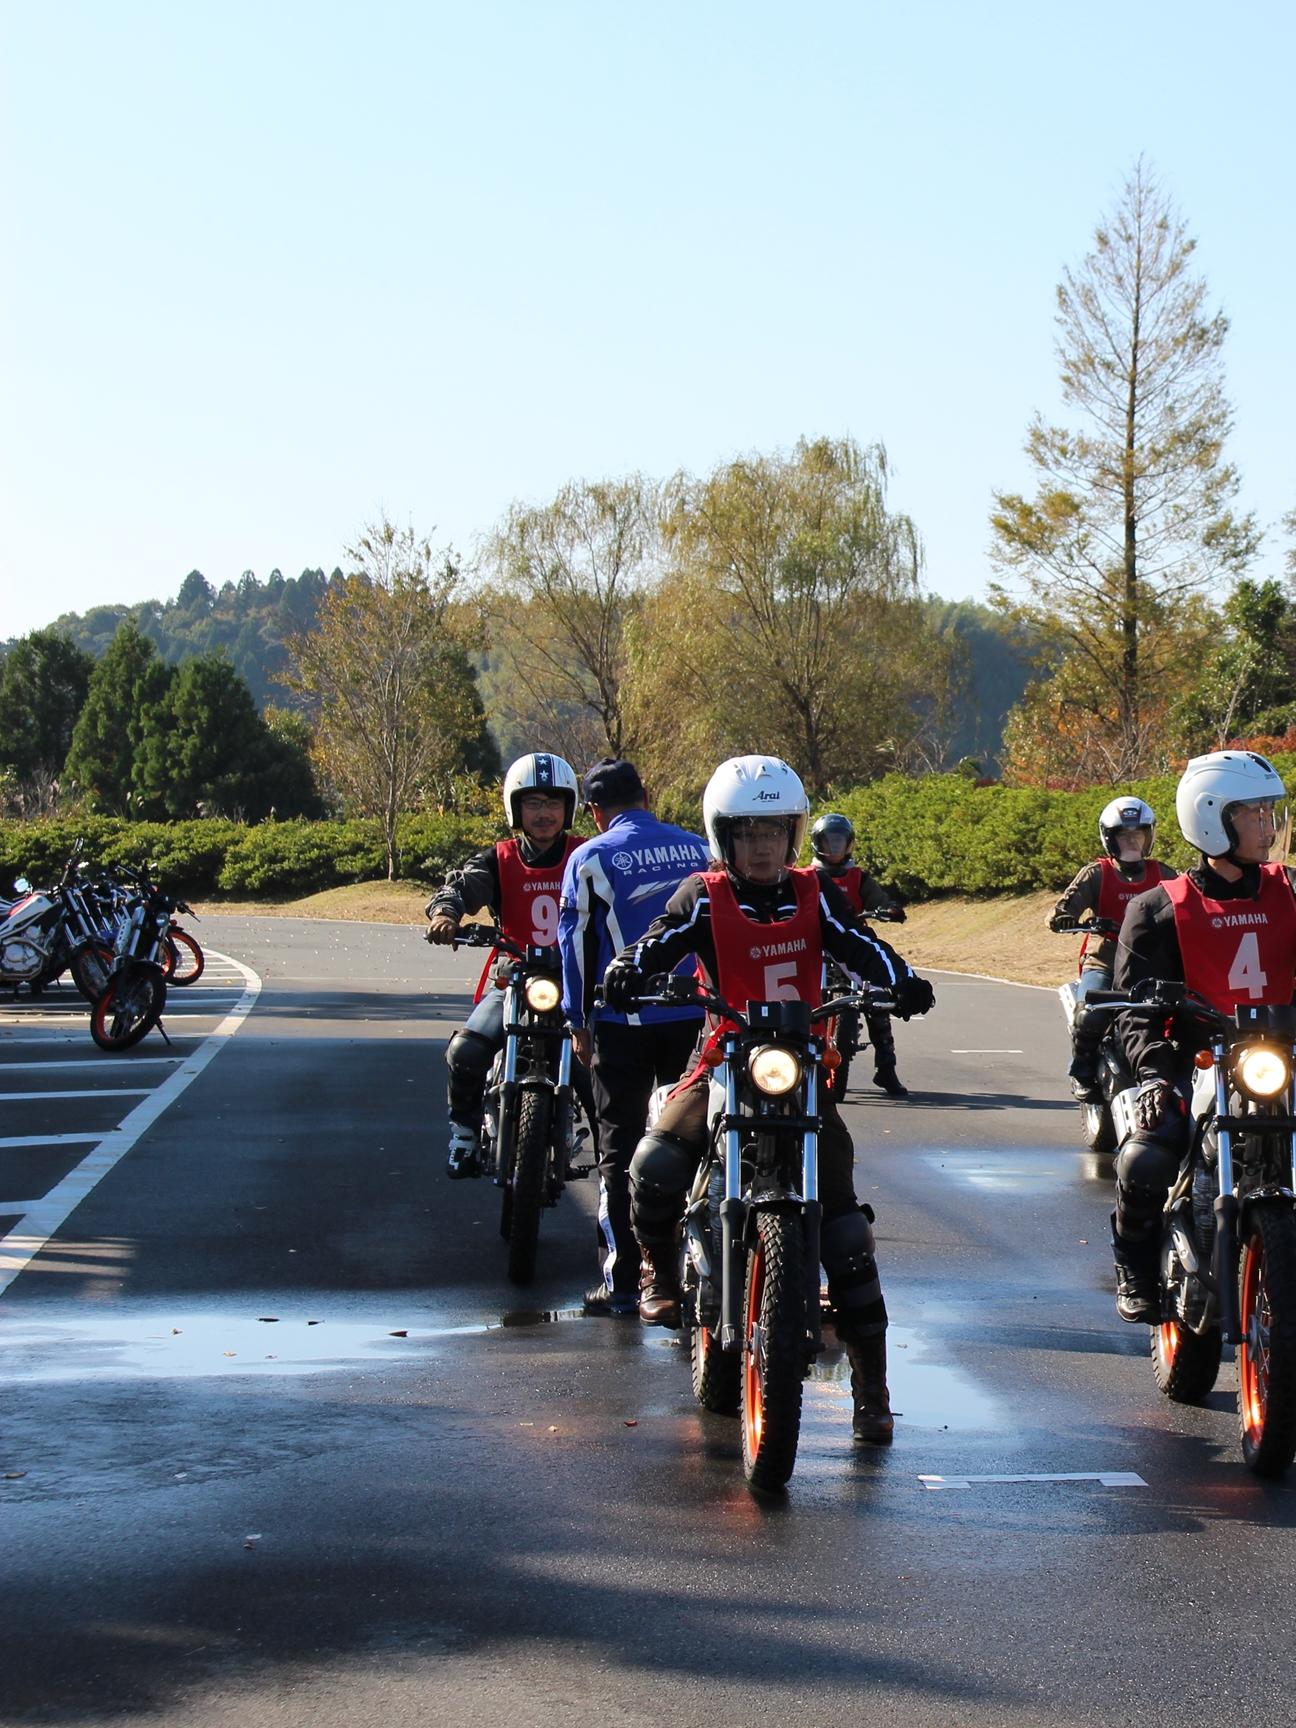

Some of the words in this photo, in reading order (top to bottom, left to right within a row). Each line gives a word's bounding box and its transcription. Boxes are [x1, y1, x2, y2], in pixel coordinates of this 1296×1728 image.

[752, 790, 780, 801] Arai
[631, 844, 701, 866] YAMAHA
[623, 862, 699, 876] RACING
[532, 881, 560, 891] YAMAH
[531, 894, 559, 947] 9
[1223, 913, 1268, 927] YAMAHA
[762, 938, 807, 957] YAMAHA
[1227, 932, 1268, 999] 4
[764, 961, 801, 1002] 5
